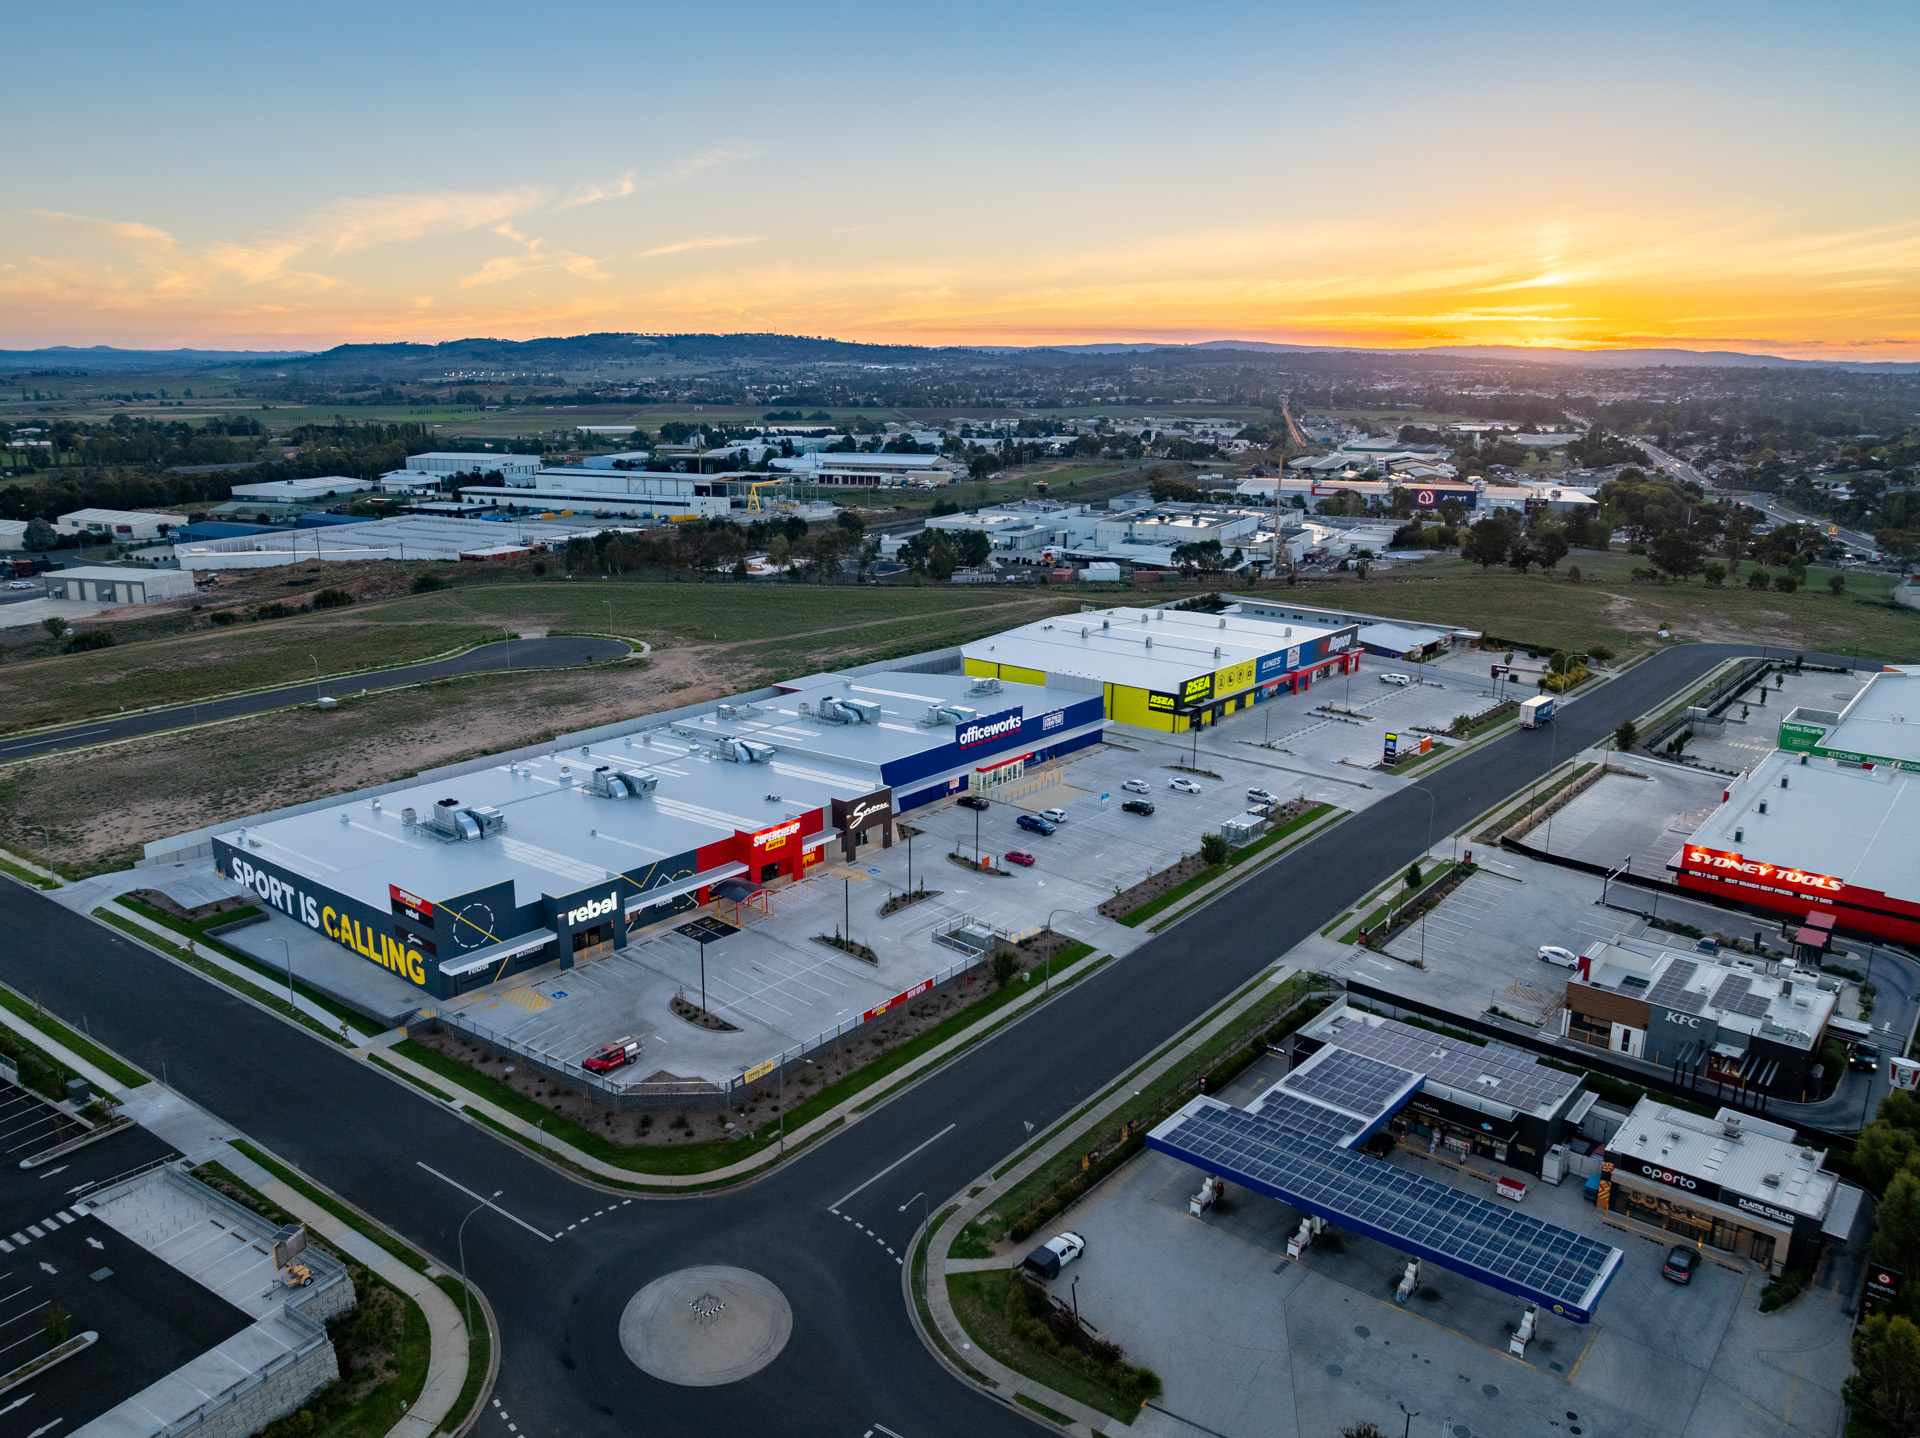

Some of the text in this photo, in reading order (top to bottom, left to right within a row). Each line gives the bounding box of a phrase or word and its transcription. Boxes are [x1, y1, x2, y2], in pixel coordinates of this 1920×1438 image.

[1327, 634, 1352, 652] Repco
[1262, 656, 1282, 670] KINGS
[1186, 676, 1210, 696] RSEA
[1150, 694, 1174, 706] RSEA
[960, 716, 1022, 744] officeworks
[1782, 724, 1824, 735] Harris Scarfe
[1827, 750, 1860, 761] KITCHEN
[1866, 756, 1894, 766] DINING
[850, 802, 890, 830] Snooze
[753, 822, 800, 847] SUPERCHEAP
[768, 838, 784, 850] AUTO
[1688, 852, 1842, 891] SYDNEY TOOLS
[1739, 880, 1760, 889] BRANDS
[1774, 888, 1794, 896] PRICES
[568, 892, 617, 926] rebel
[232, 857, 426, 985] SPORT IS CALLING
[516, 944, 544, 958] BATHURST
[1665, 1011, 1700, 1028] KFC
[1642, 1166, 1696, 1190] oporto
[1738, 1204, 1770, 1217] PORTUGUESE
[1739, 1198, 1795, 1220] FLAME GRILLED
[1868, 1282, 1896, 1295] oporto
